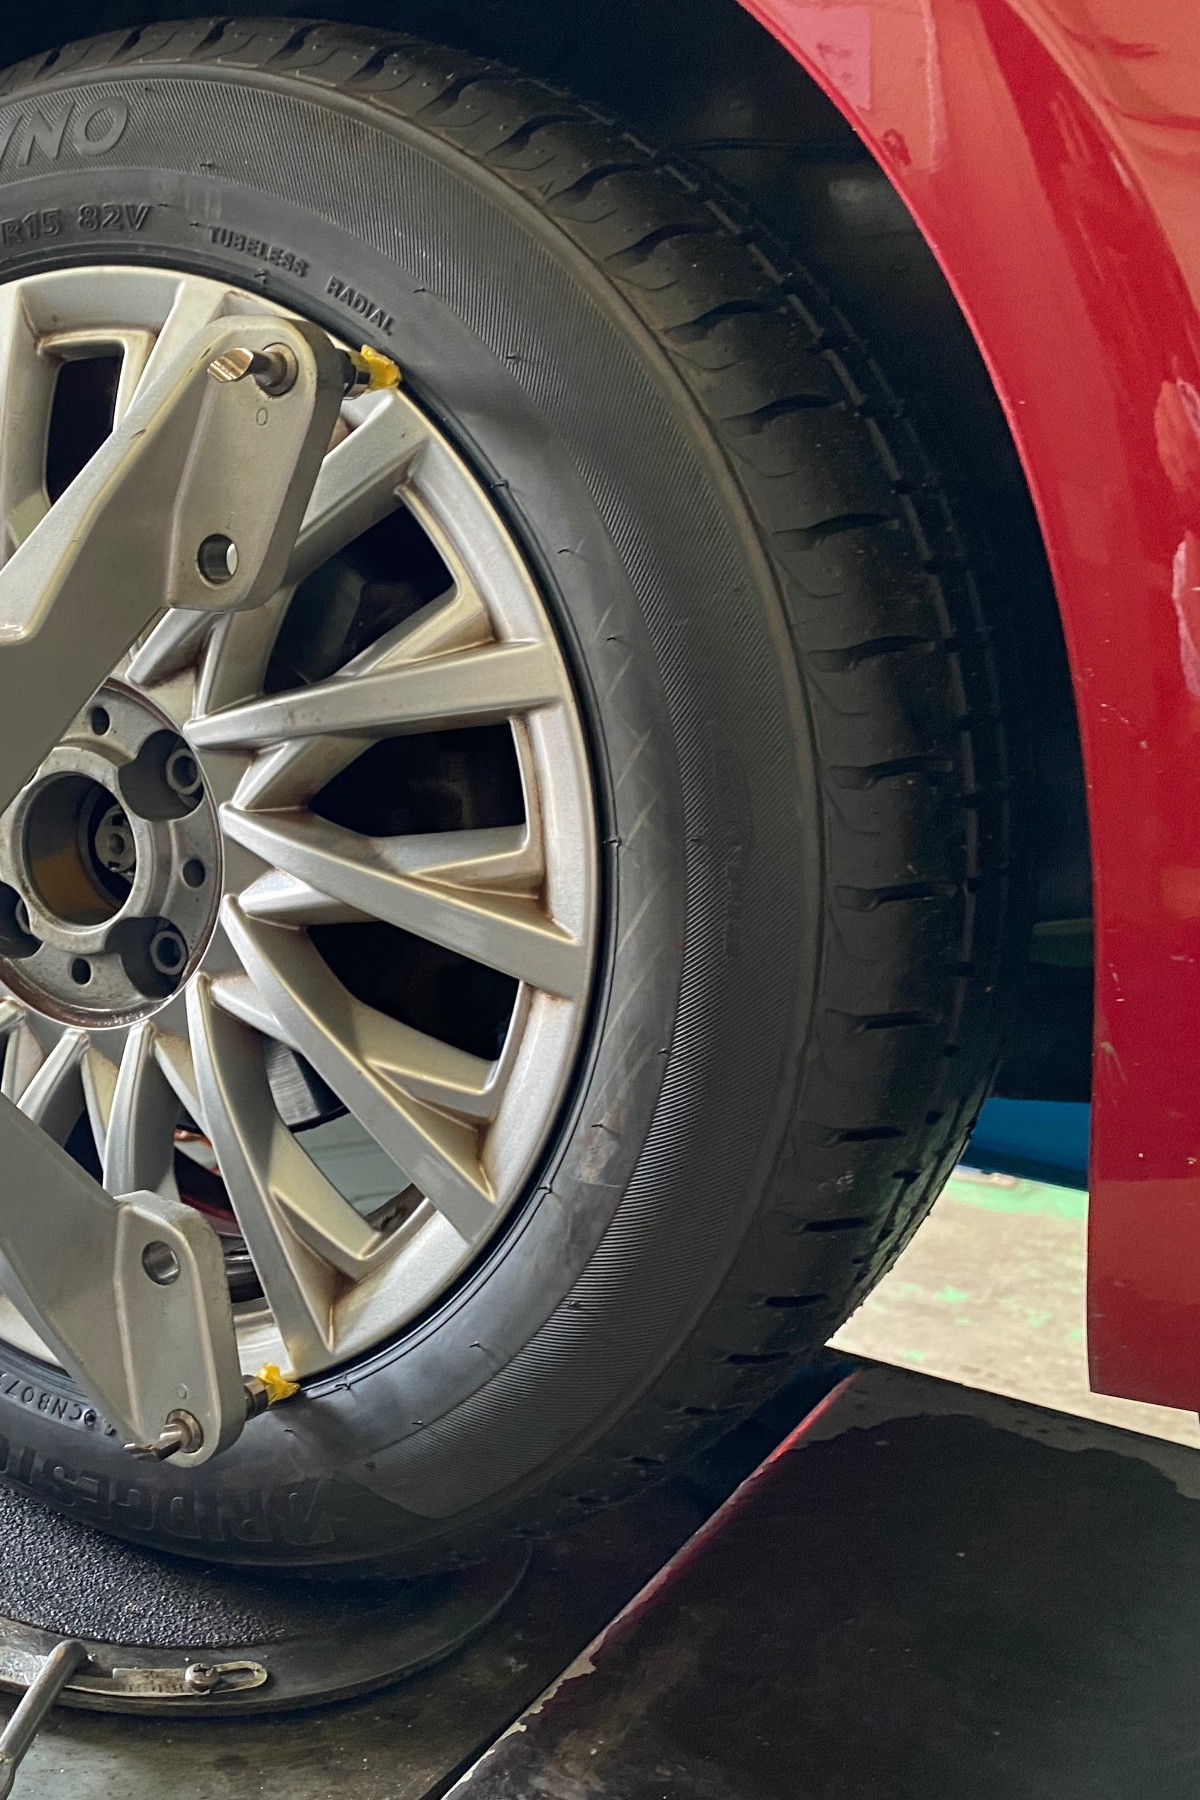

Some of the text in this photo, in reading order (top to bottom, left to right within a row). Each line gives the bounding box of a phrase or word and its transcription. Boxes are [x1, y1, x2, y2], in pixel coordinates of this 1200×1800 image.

[1, 208, 61, 247] R15
[78, 203, 152, 232] 82V
[208, 226, 395, 336] TUBELESS RADIAL
